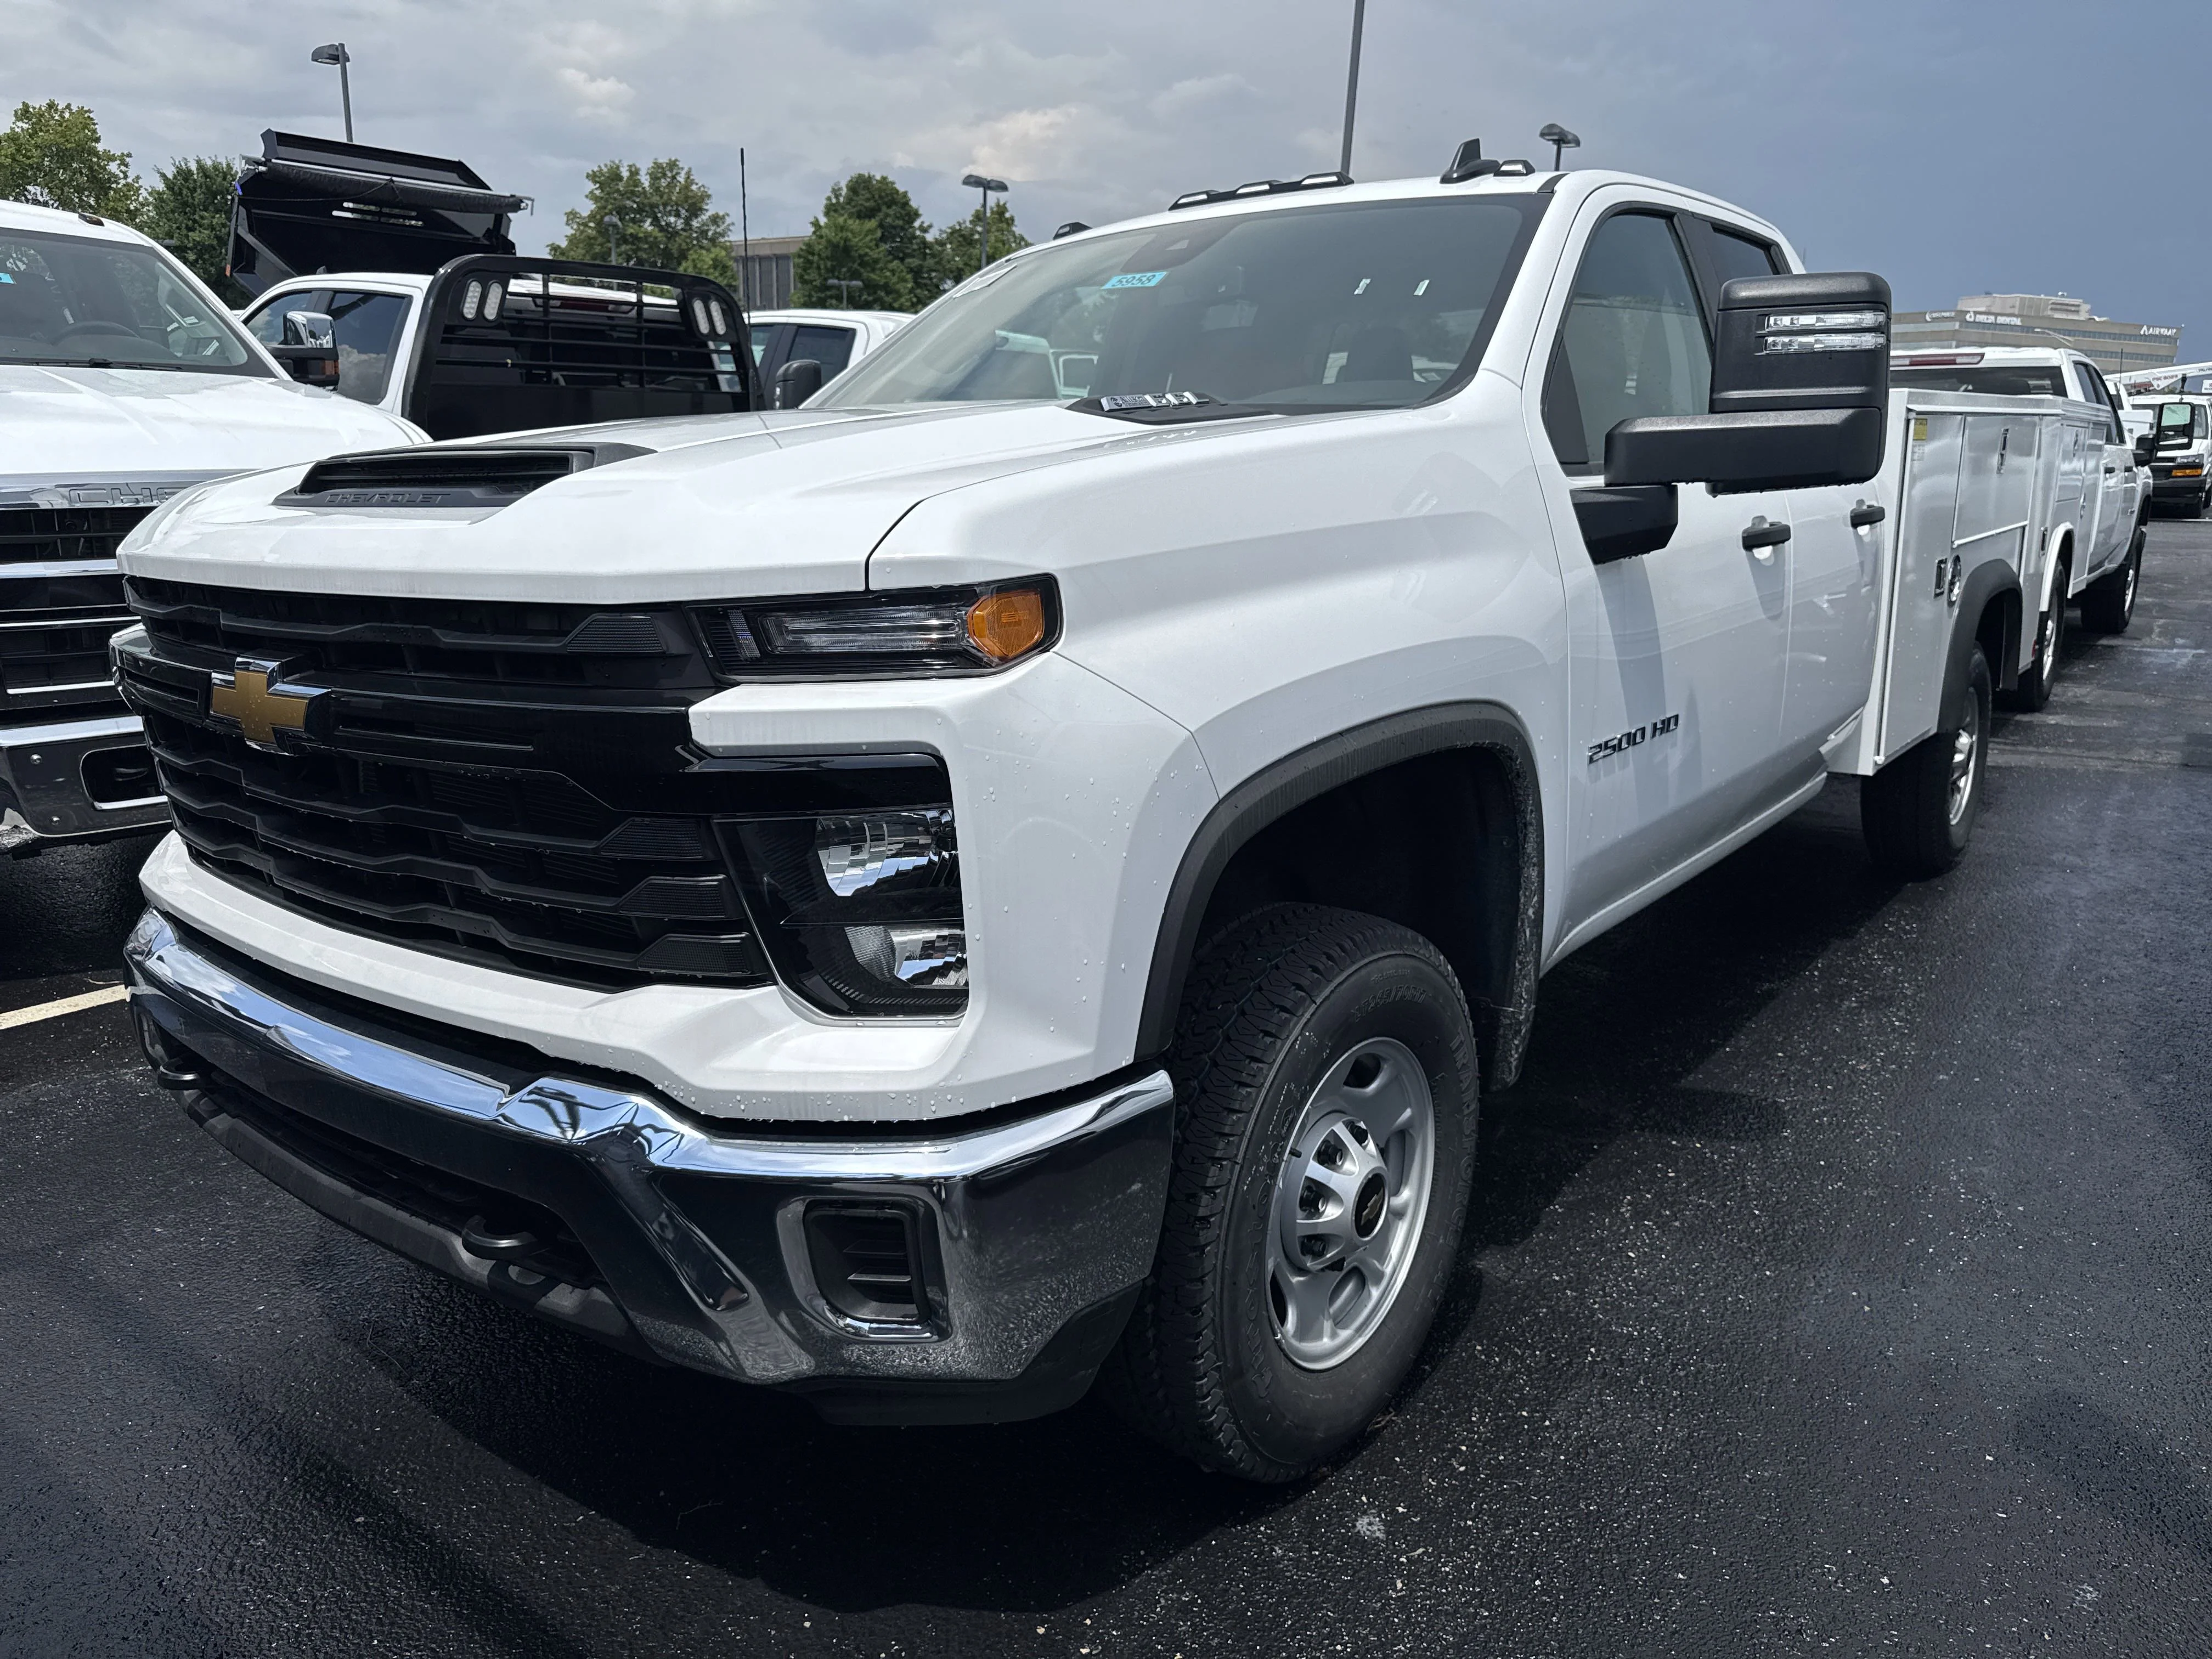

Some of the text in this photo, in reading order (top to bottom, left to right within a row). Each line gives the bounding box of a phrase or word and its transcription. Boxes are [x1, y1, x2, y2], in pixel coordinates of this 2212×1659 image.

[1111, 275, 1156, 286] 5958
[325, 493, 452, 504] CHEVROLET
[1587, 713, 1679, 765] 2500 HD
